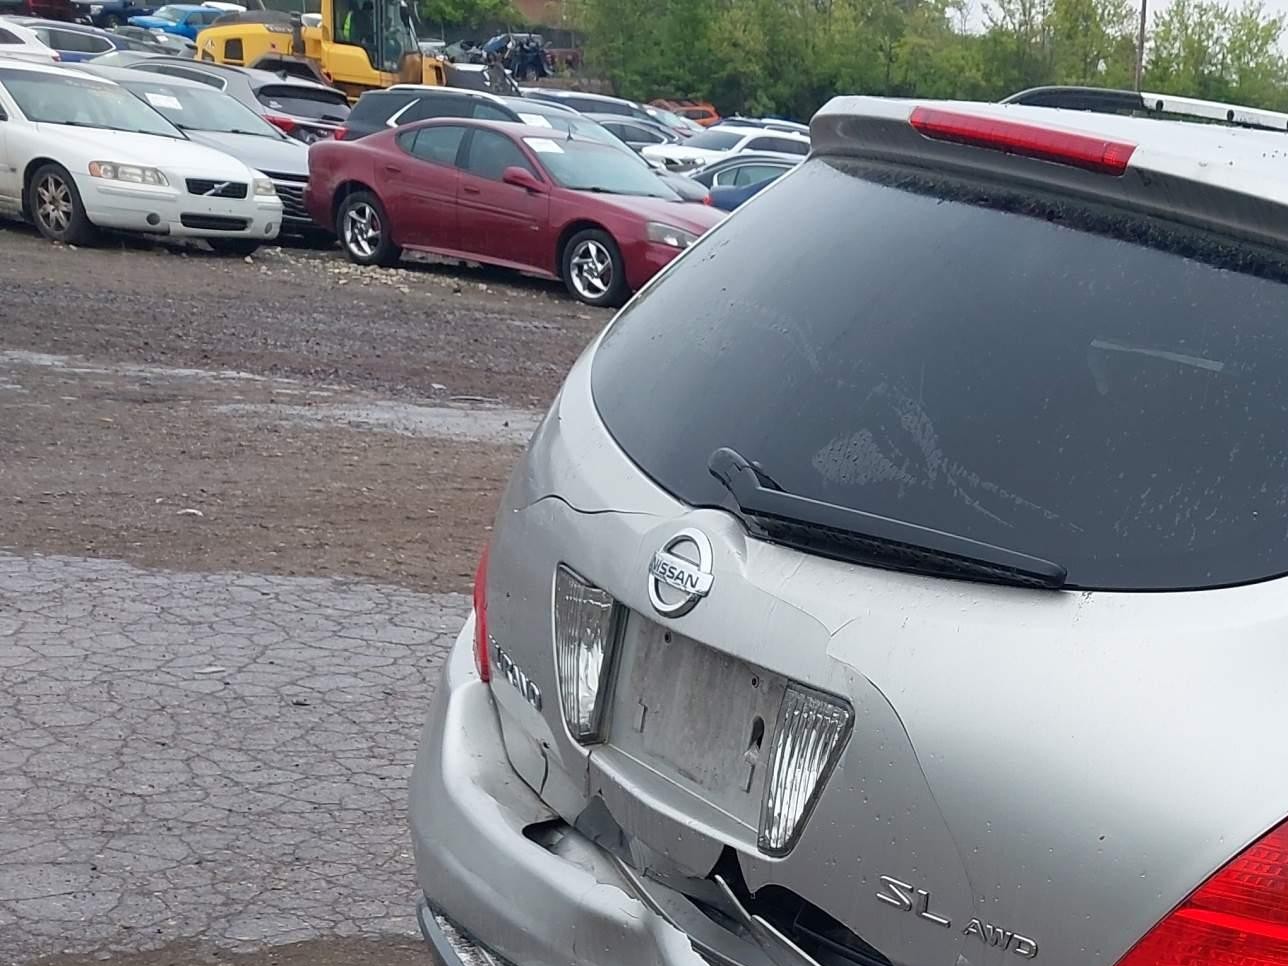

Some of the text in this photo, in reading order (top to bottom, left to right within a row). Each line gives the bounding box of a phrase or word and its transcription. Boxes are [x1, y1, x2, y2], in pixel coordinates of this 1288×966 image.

[653, 558, 700, 589] NISSAN
[875, 874, 1039, 960] SL AWD
